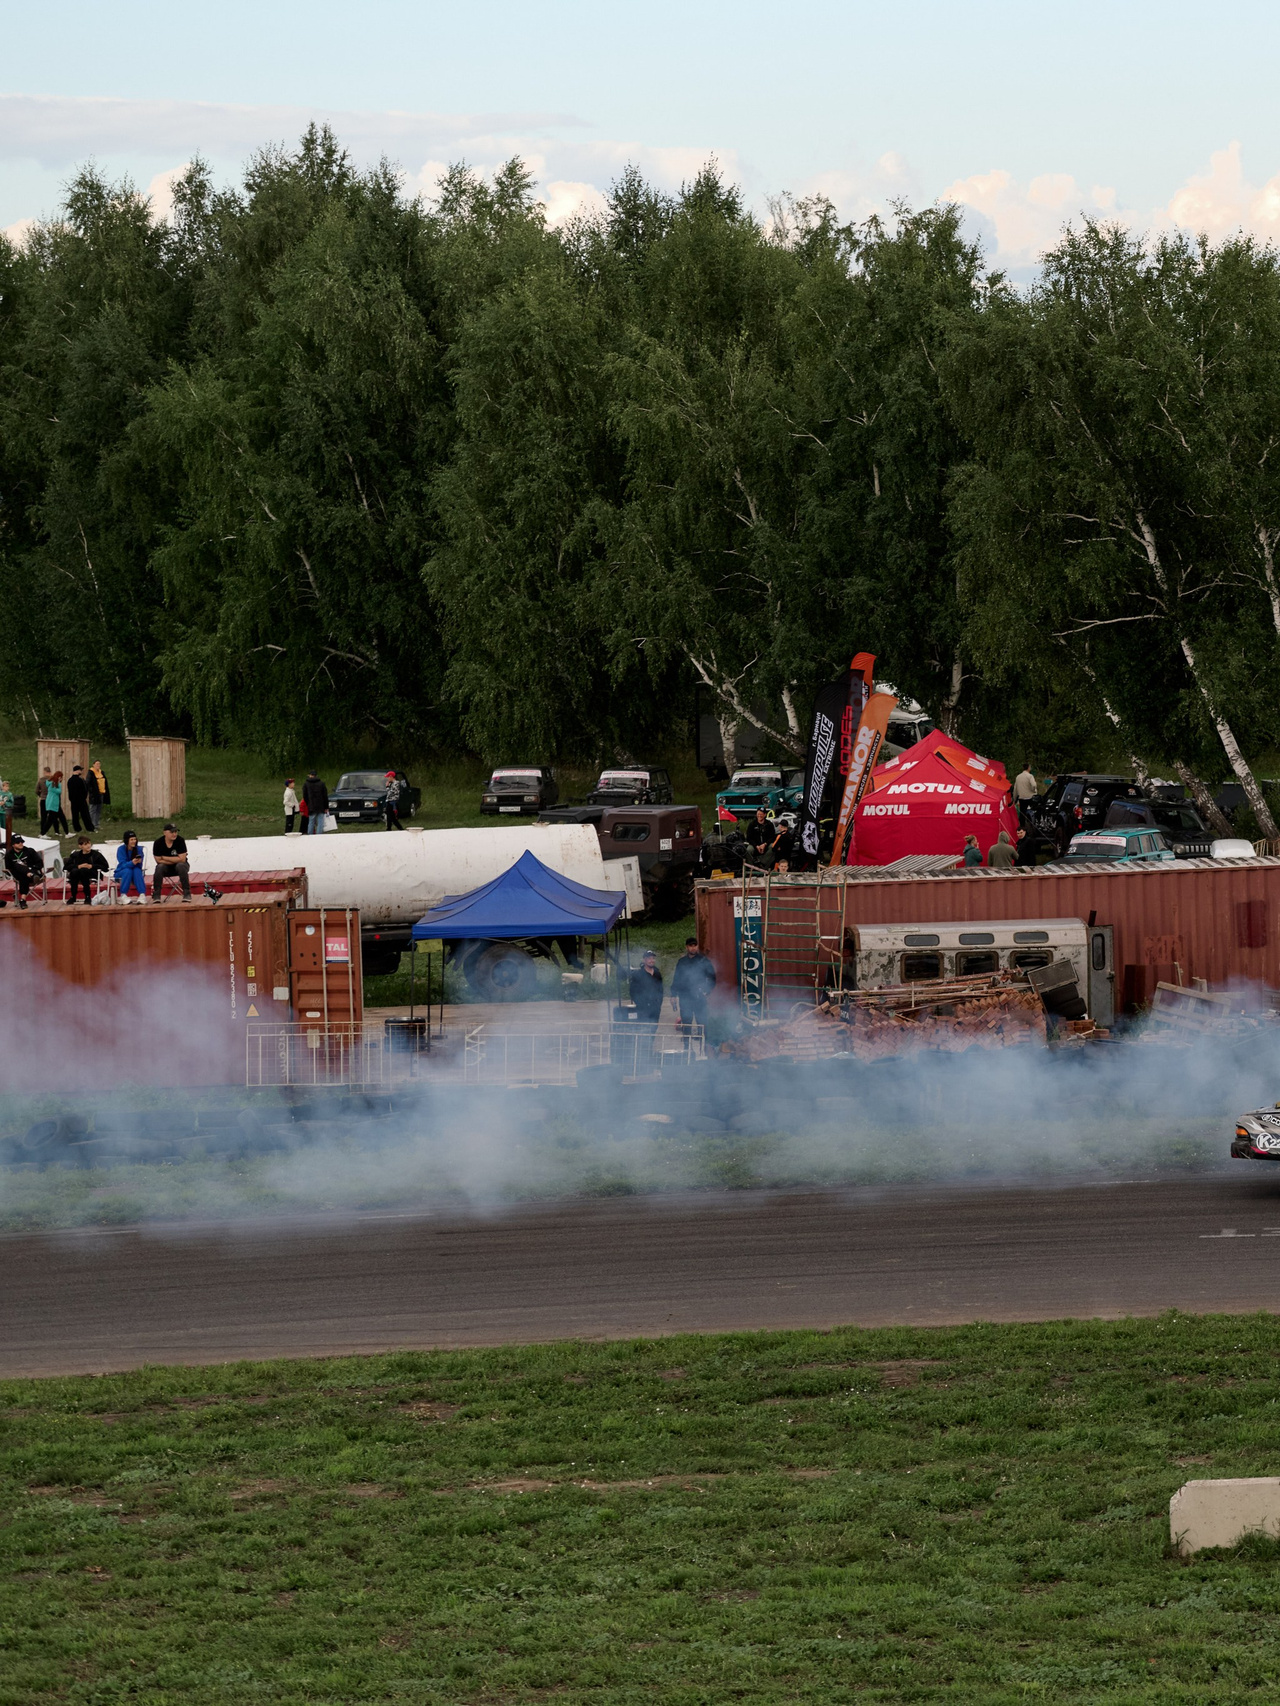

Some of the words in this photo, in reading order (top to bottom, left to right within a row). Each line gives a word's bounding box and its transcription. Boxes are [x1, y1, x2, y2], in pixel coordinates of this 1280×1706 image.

[823, 739, 836, 774] EXTREME
[808, 714, 834, 818] MOTOPULSE
[858, 774, 867, 796] масла
[886, 782, 965, 795] MOTUL
[862, 804, 911, 816] MOTUL
[944, 803, 993, 815] MOTUL
[326, 943, 348, 951] TAL
